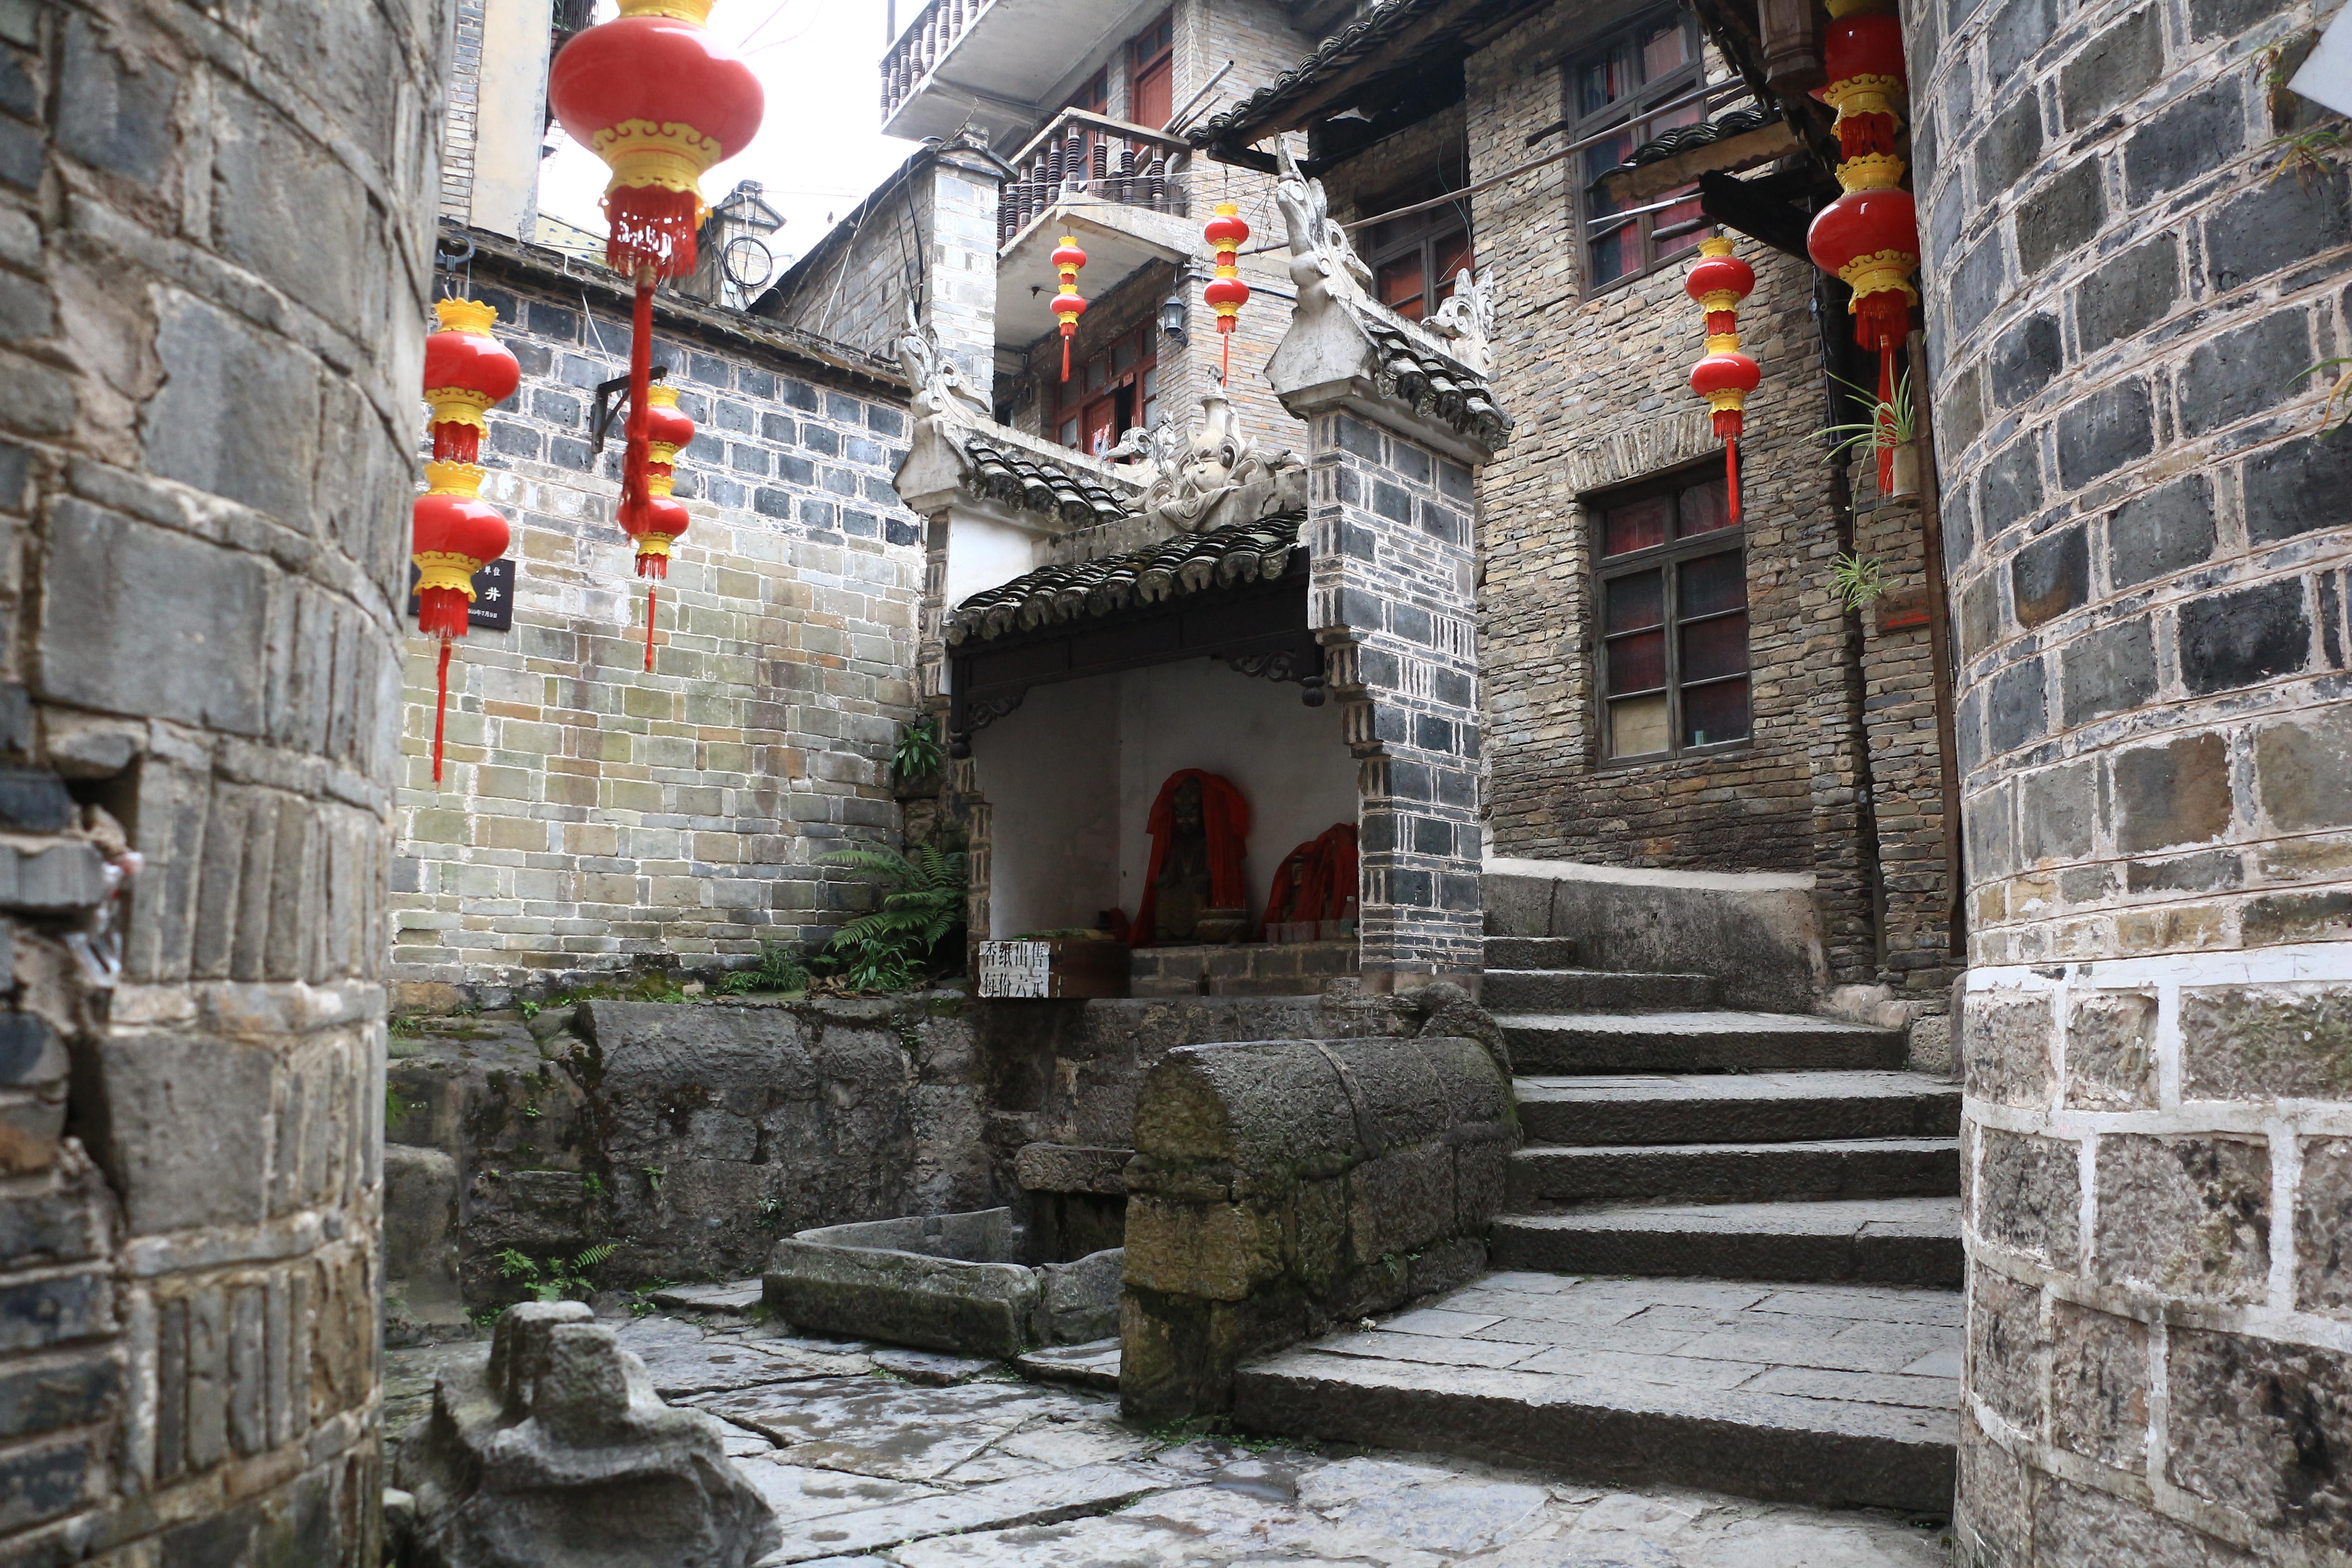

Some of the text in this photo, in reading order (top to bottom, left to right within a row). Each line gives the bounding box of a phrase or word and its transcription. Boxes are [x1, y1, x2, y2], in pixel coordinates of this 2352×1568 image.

[476, 565, 501, 577] 单位
[485, 587, 501, 602] 井
[985, 941, 1044, 968] 香纸出售
[983, 972, 1044, 997] 每份六元
